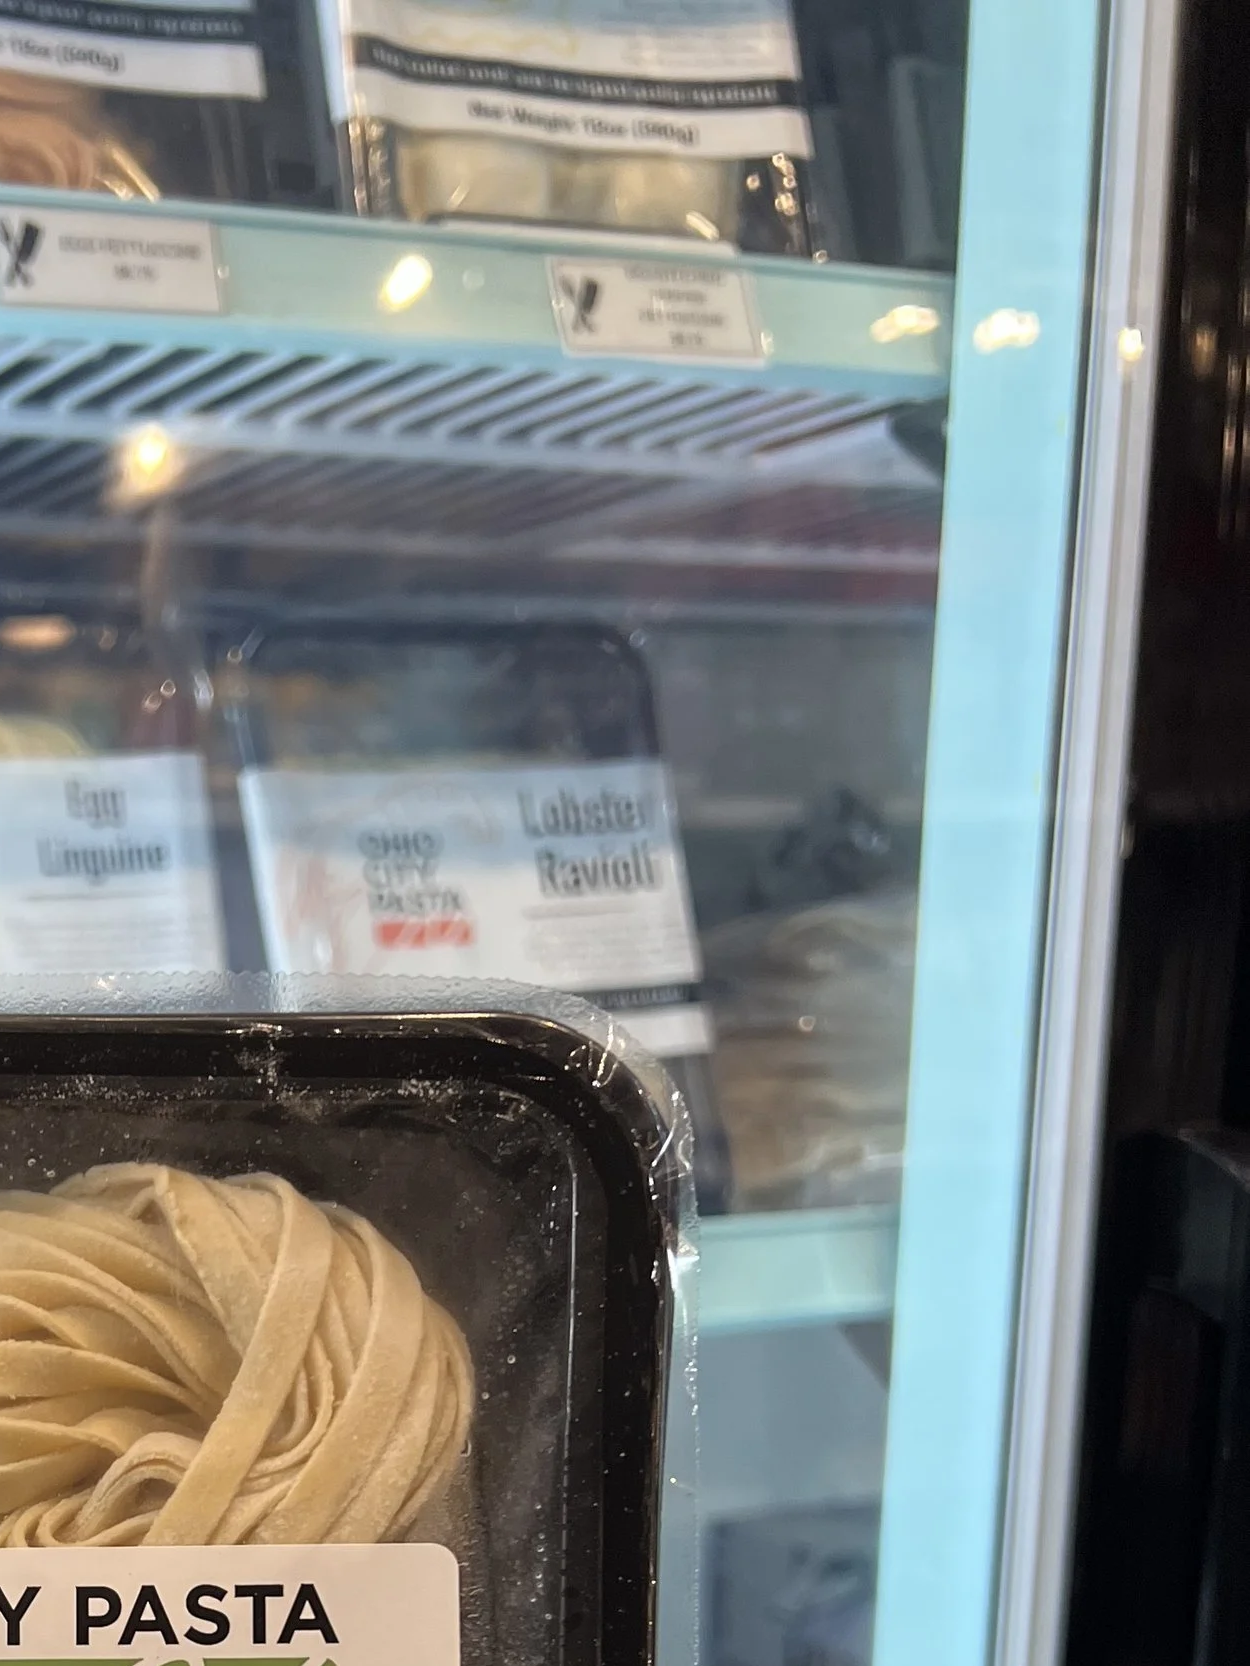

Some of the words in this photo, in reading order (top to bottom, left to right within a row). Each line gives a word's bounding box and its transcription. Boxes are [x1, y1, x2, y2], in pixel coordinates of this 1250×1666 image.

[516, 786, 649, 837] Lobster
[37, 835, 171, 887] Linguine
[358, 827, 443, 859] OHIO
[362, 860, 438, 887] CITY
[533, 842, 662, 898] Ravioli
[368, 888, 465, 915] PASTA
[76, 1583, 340, 1646] PASTA
